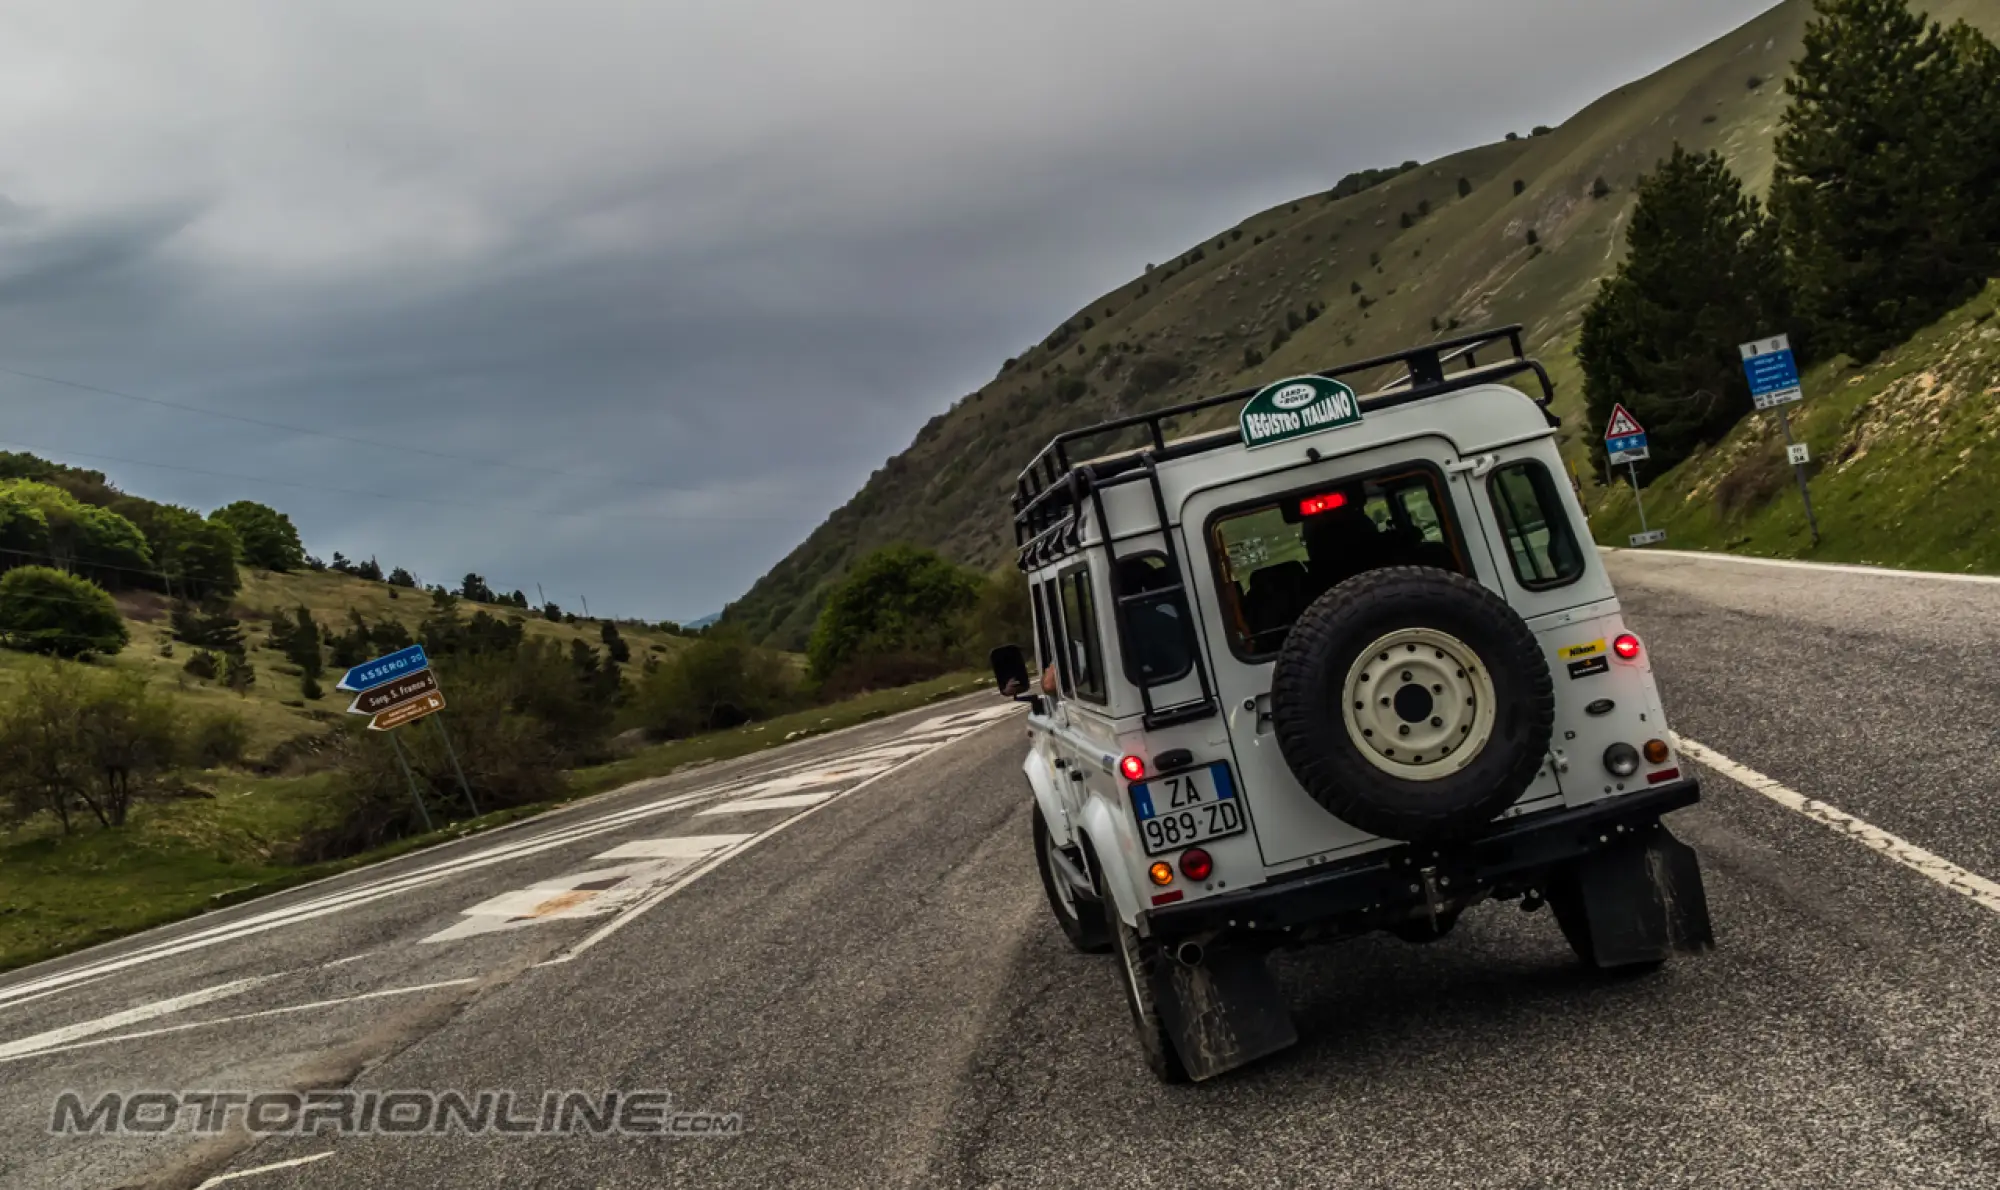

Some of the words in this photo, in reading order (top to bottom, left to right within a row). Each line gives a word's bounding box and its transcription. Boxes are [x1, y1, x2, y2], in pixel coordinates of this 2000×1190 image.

[1246, 411, 1300, 440] REGISTRO
[1301, 390, 1351, 427] ITALIANO
[1569, 644, 1596, 657] Nikon
[360, 658, 409, 682] ASSERGI
[1164, 775, 1201, 808] ZA
